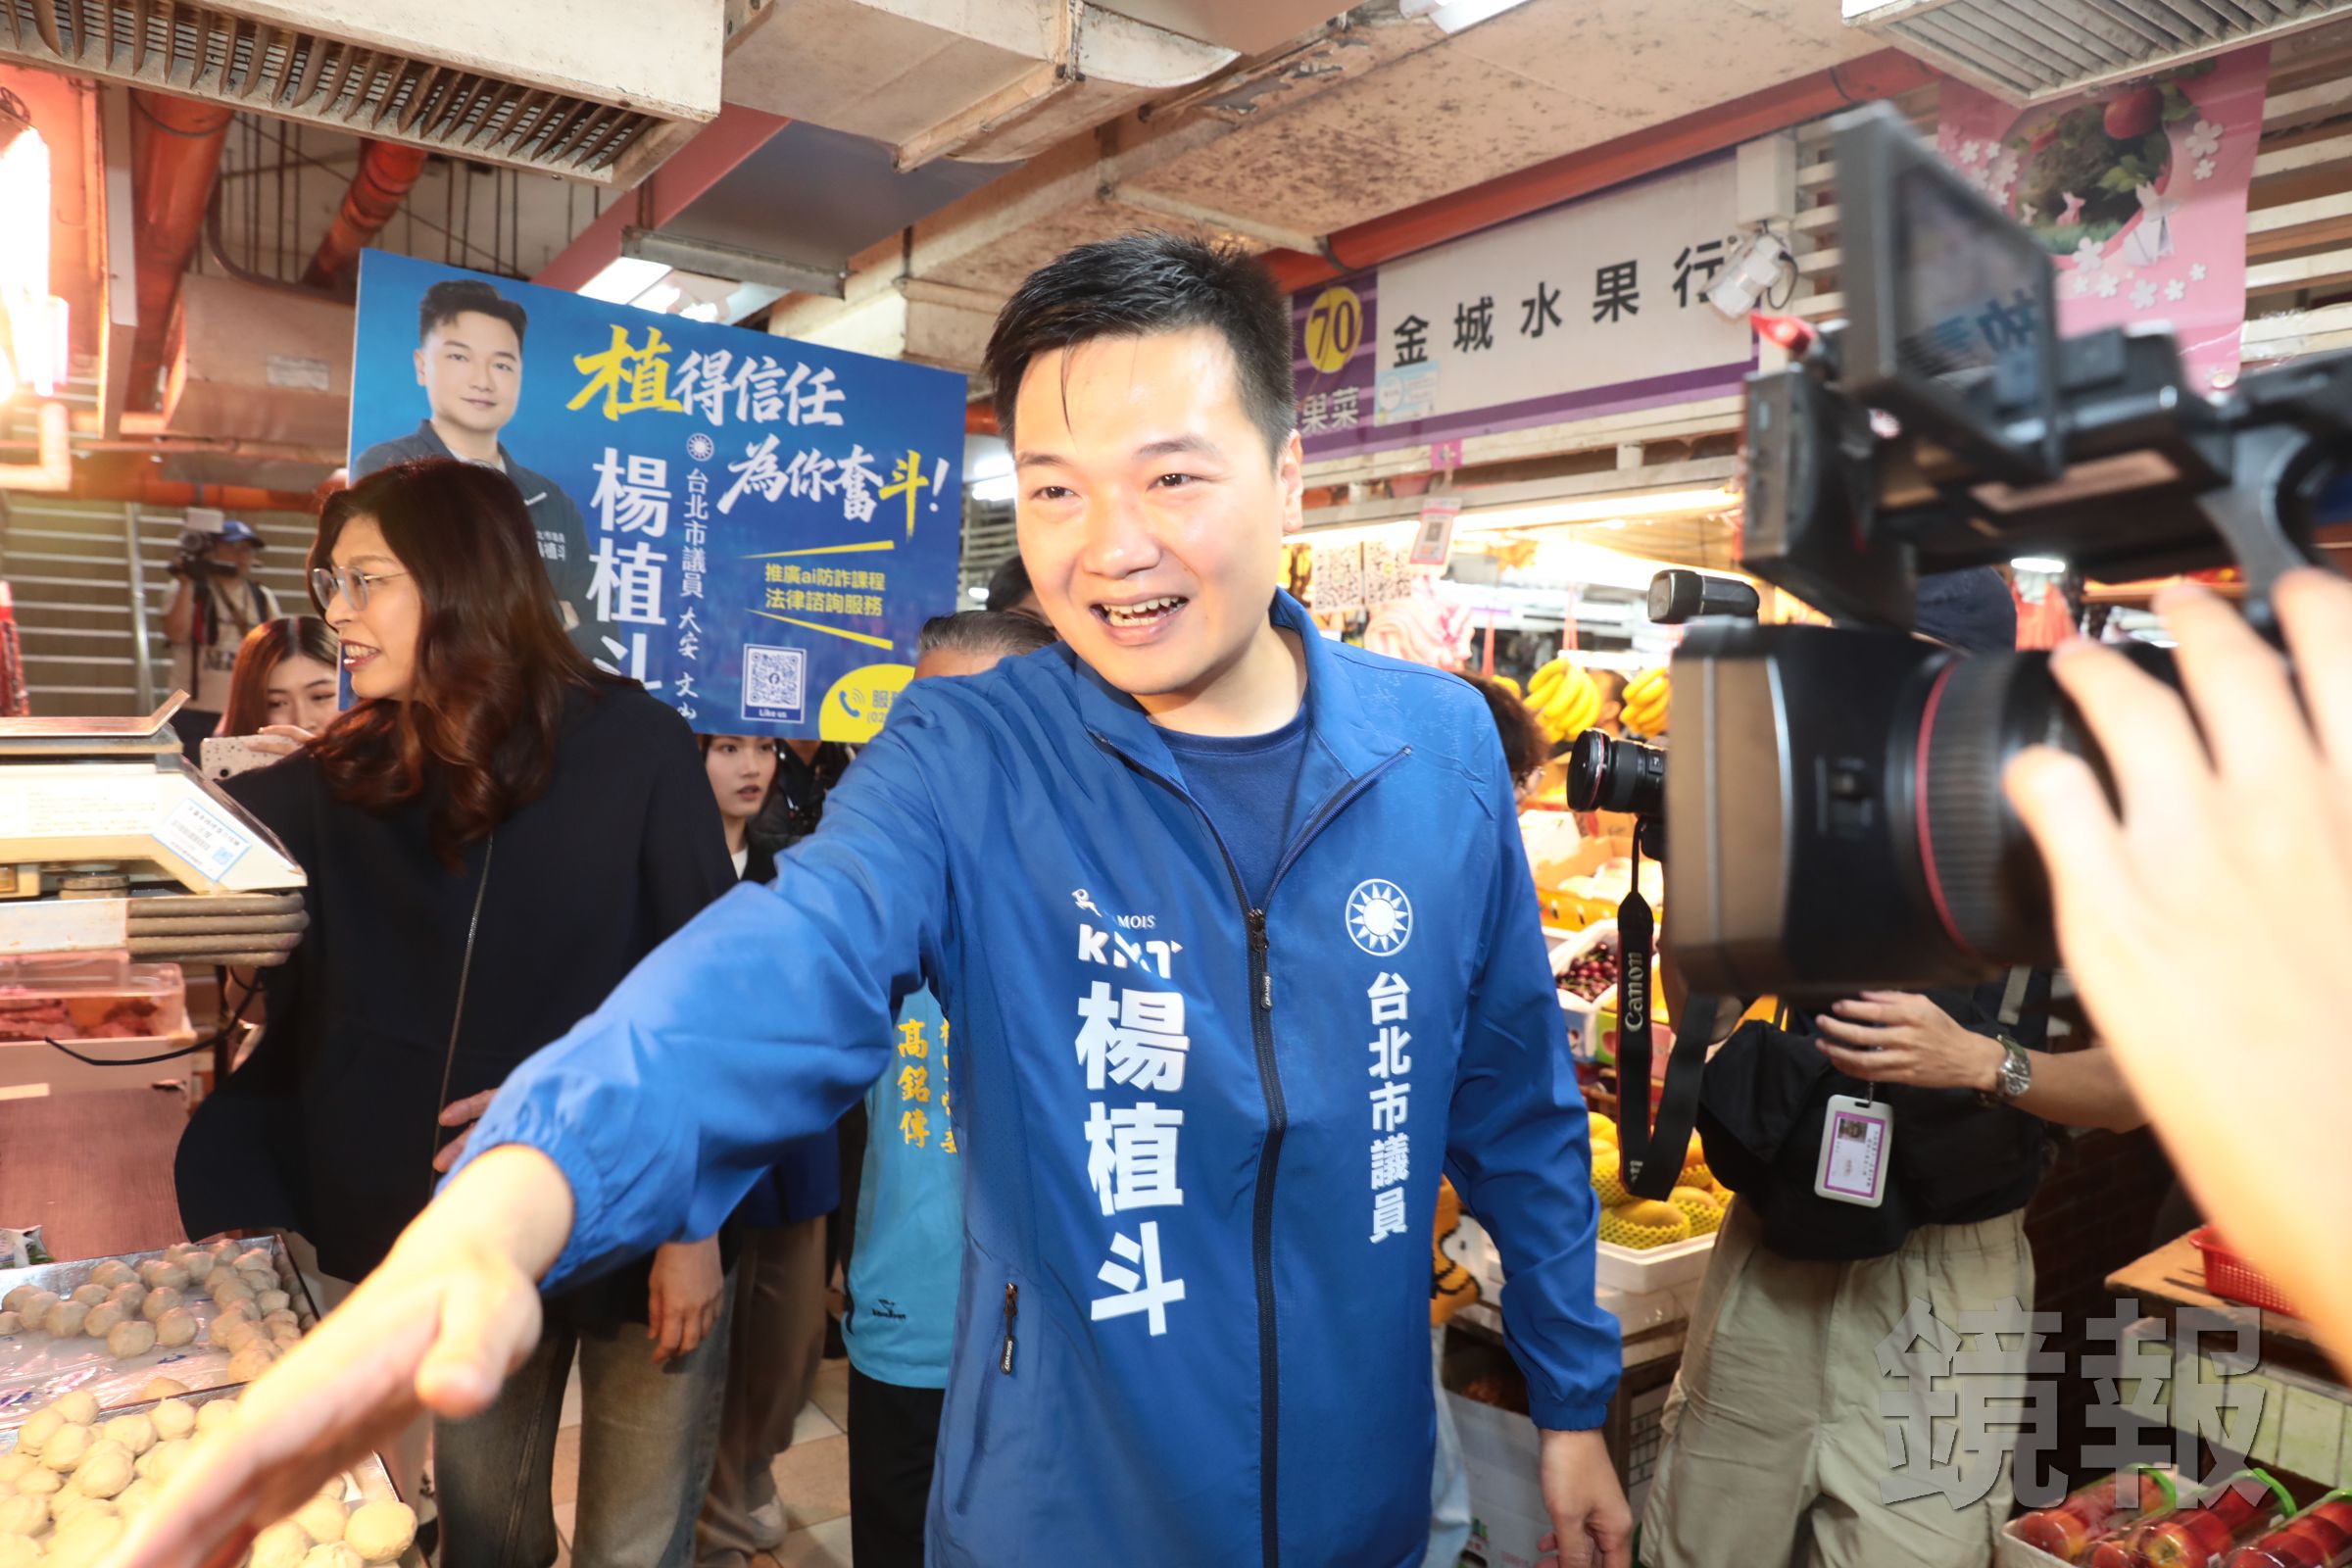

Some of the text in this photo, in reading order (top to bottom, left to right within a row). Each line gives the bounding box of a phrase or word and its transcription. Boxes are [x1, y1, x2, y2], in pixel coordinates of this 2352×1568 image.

[1311, 300, 1355, 361] 70
[1393, 239, 1725, 368] 金城水果行
[565, 323, 847, 426] 植得信任
[1301, 386, 1360, 435] 果菜
[680, 467, 709, 599] 台北市議員
[764, 563, 886, 591] 推廣ai防詐課程
[764, 588, 884, 616] 法律諮詢服務
[677, 606, 703, 661] 大安
[1625, 952, 1644, 1032] Canon
[1366, 971, 1412, 1244] 台北市議員
[1074, 980, 1191, 1337] 楊植斗
